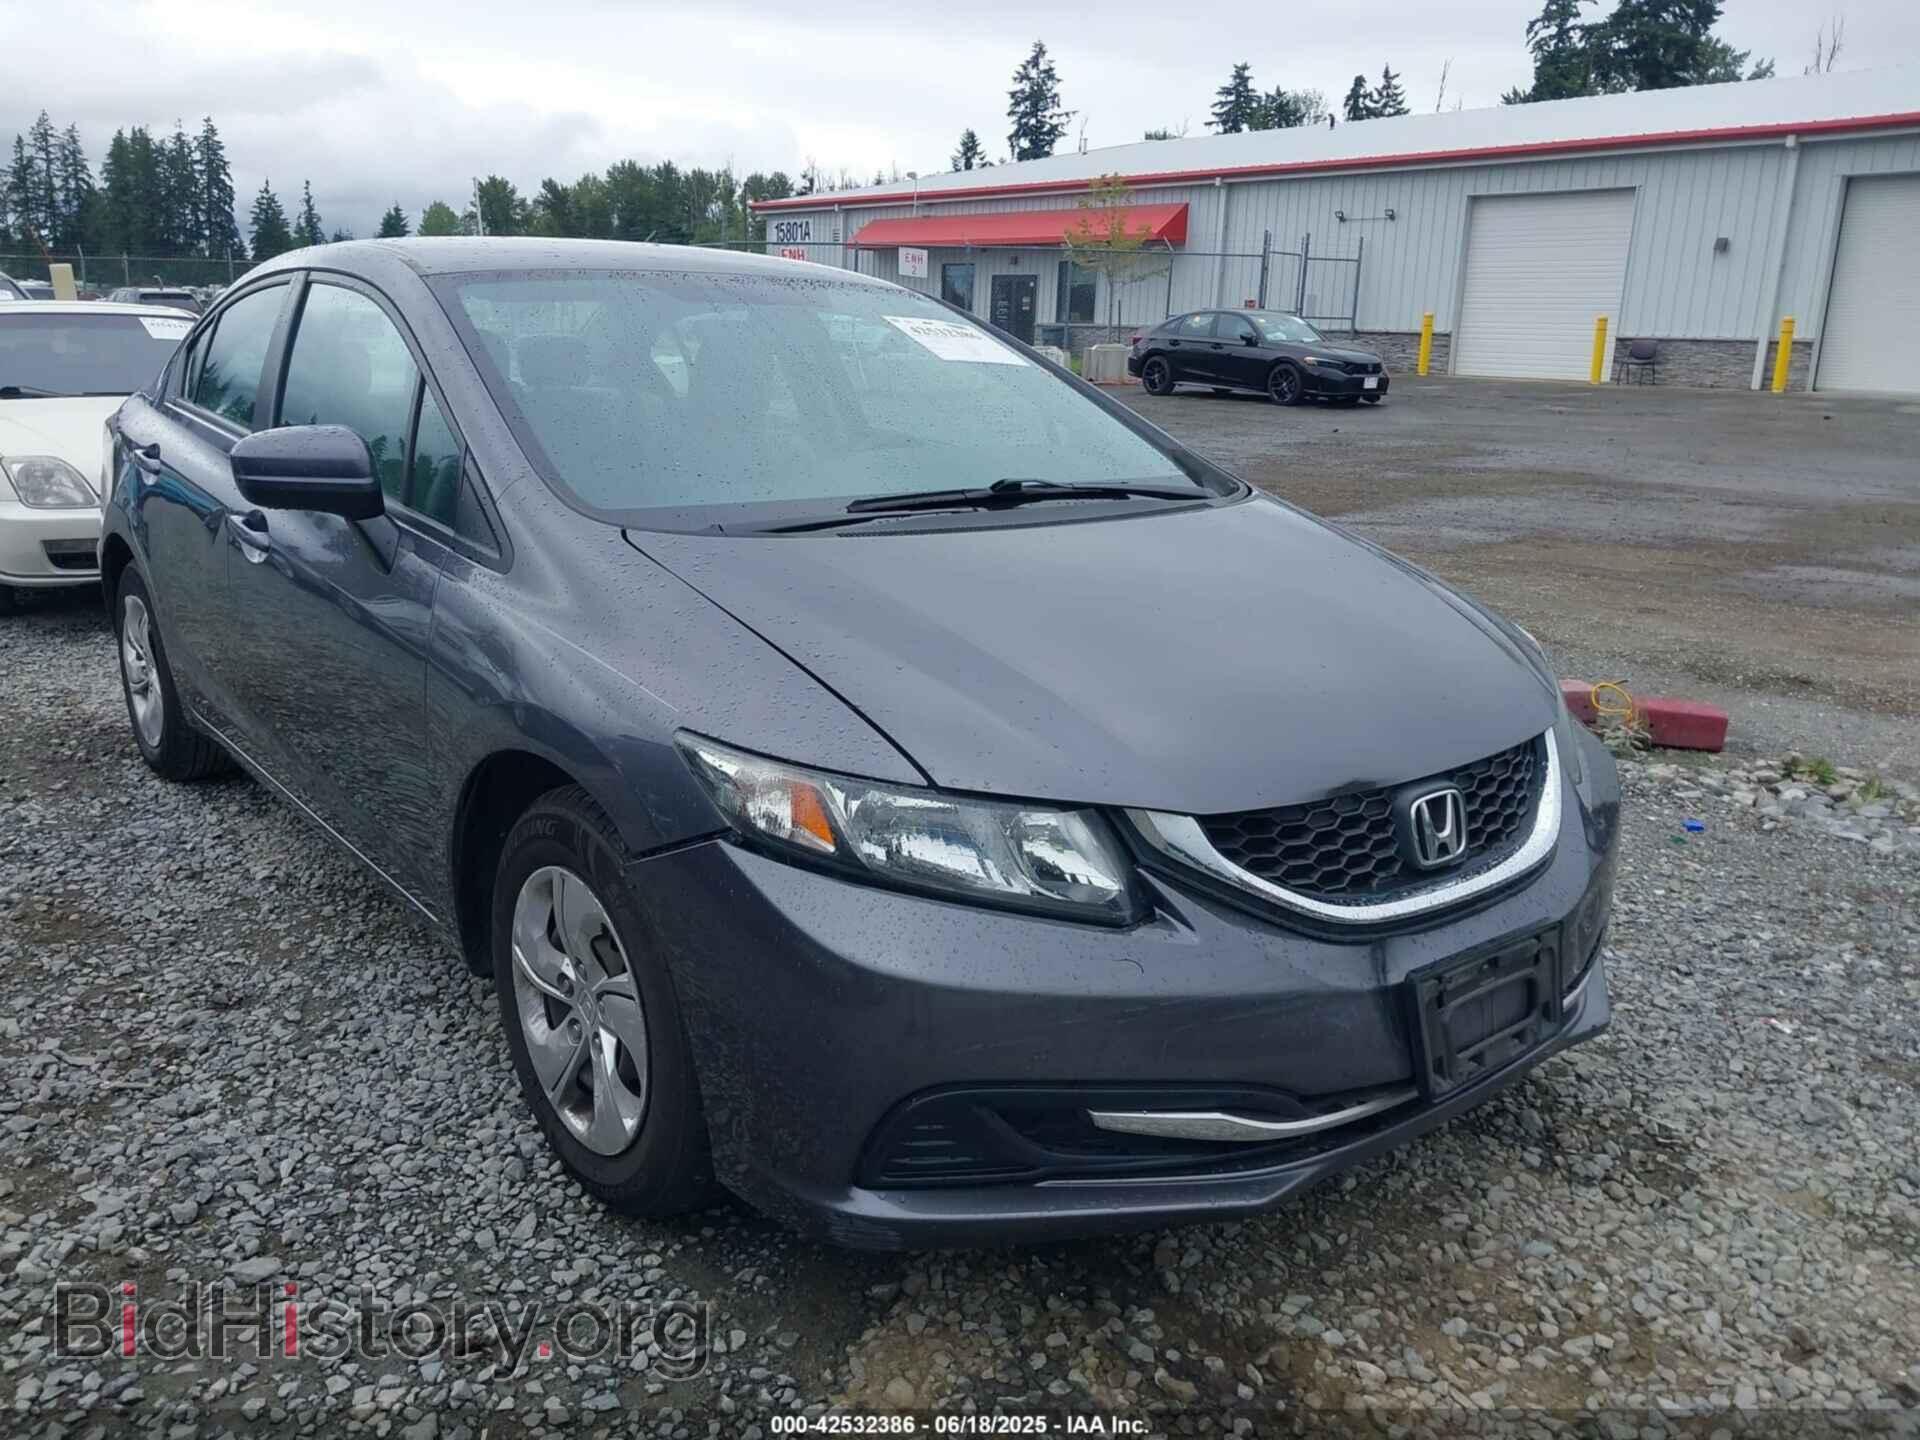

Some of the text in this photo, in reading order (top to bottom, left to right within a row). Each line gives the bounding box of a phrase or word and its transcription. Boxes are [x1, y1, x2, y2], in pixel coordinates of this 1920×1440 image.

[775, 221, 811, 242] 15801A
[904, 252, 924, 264] ENH
[911, 265, 918, 275] 2
